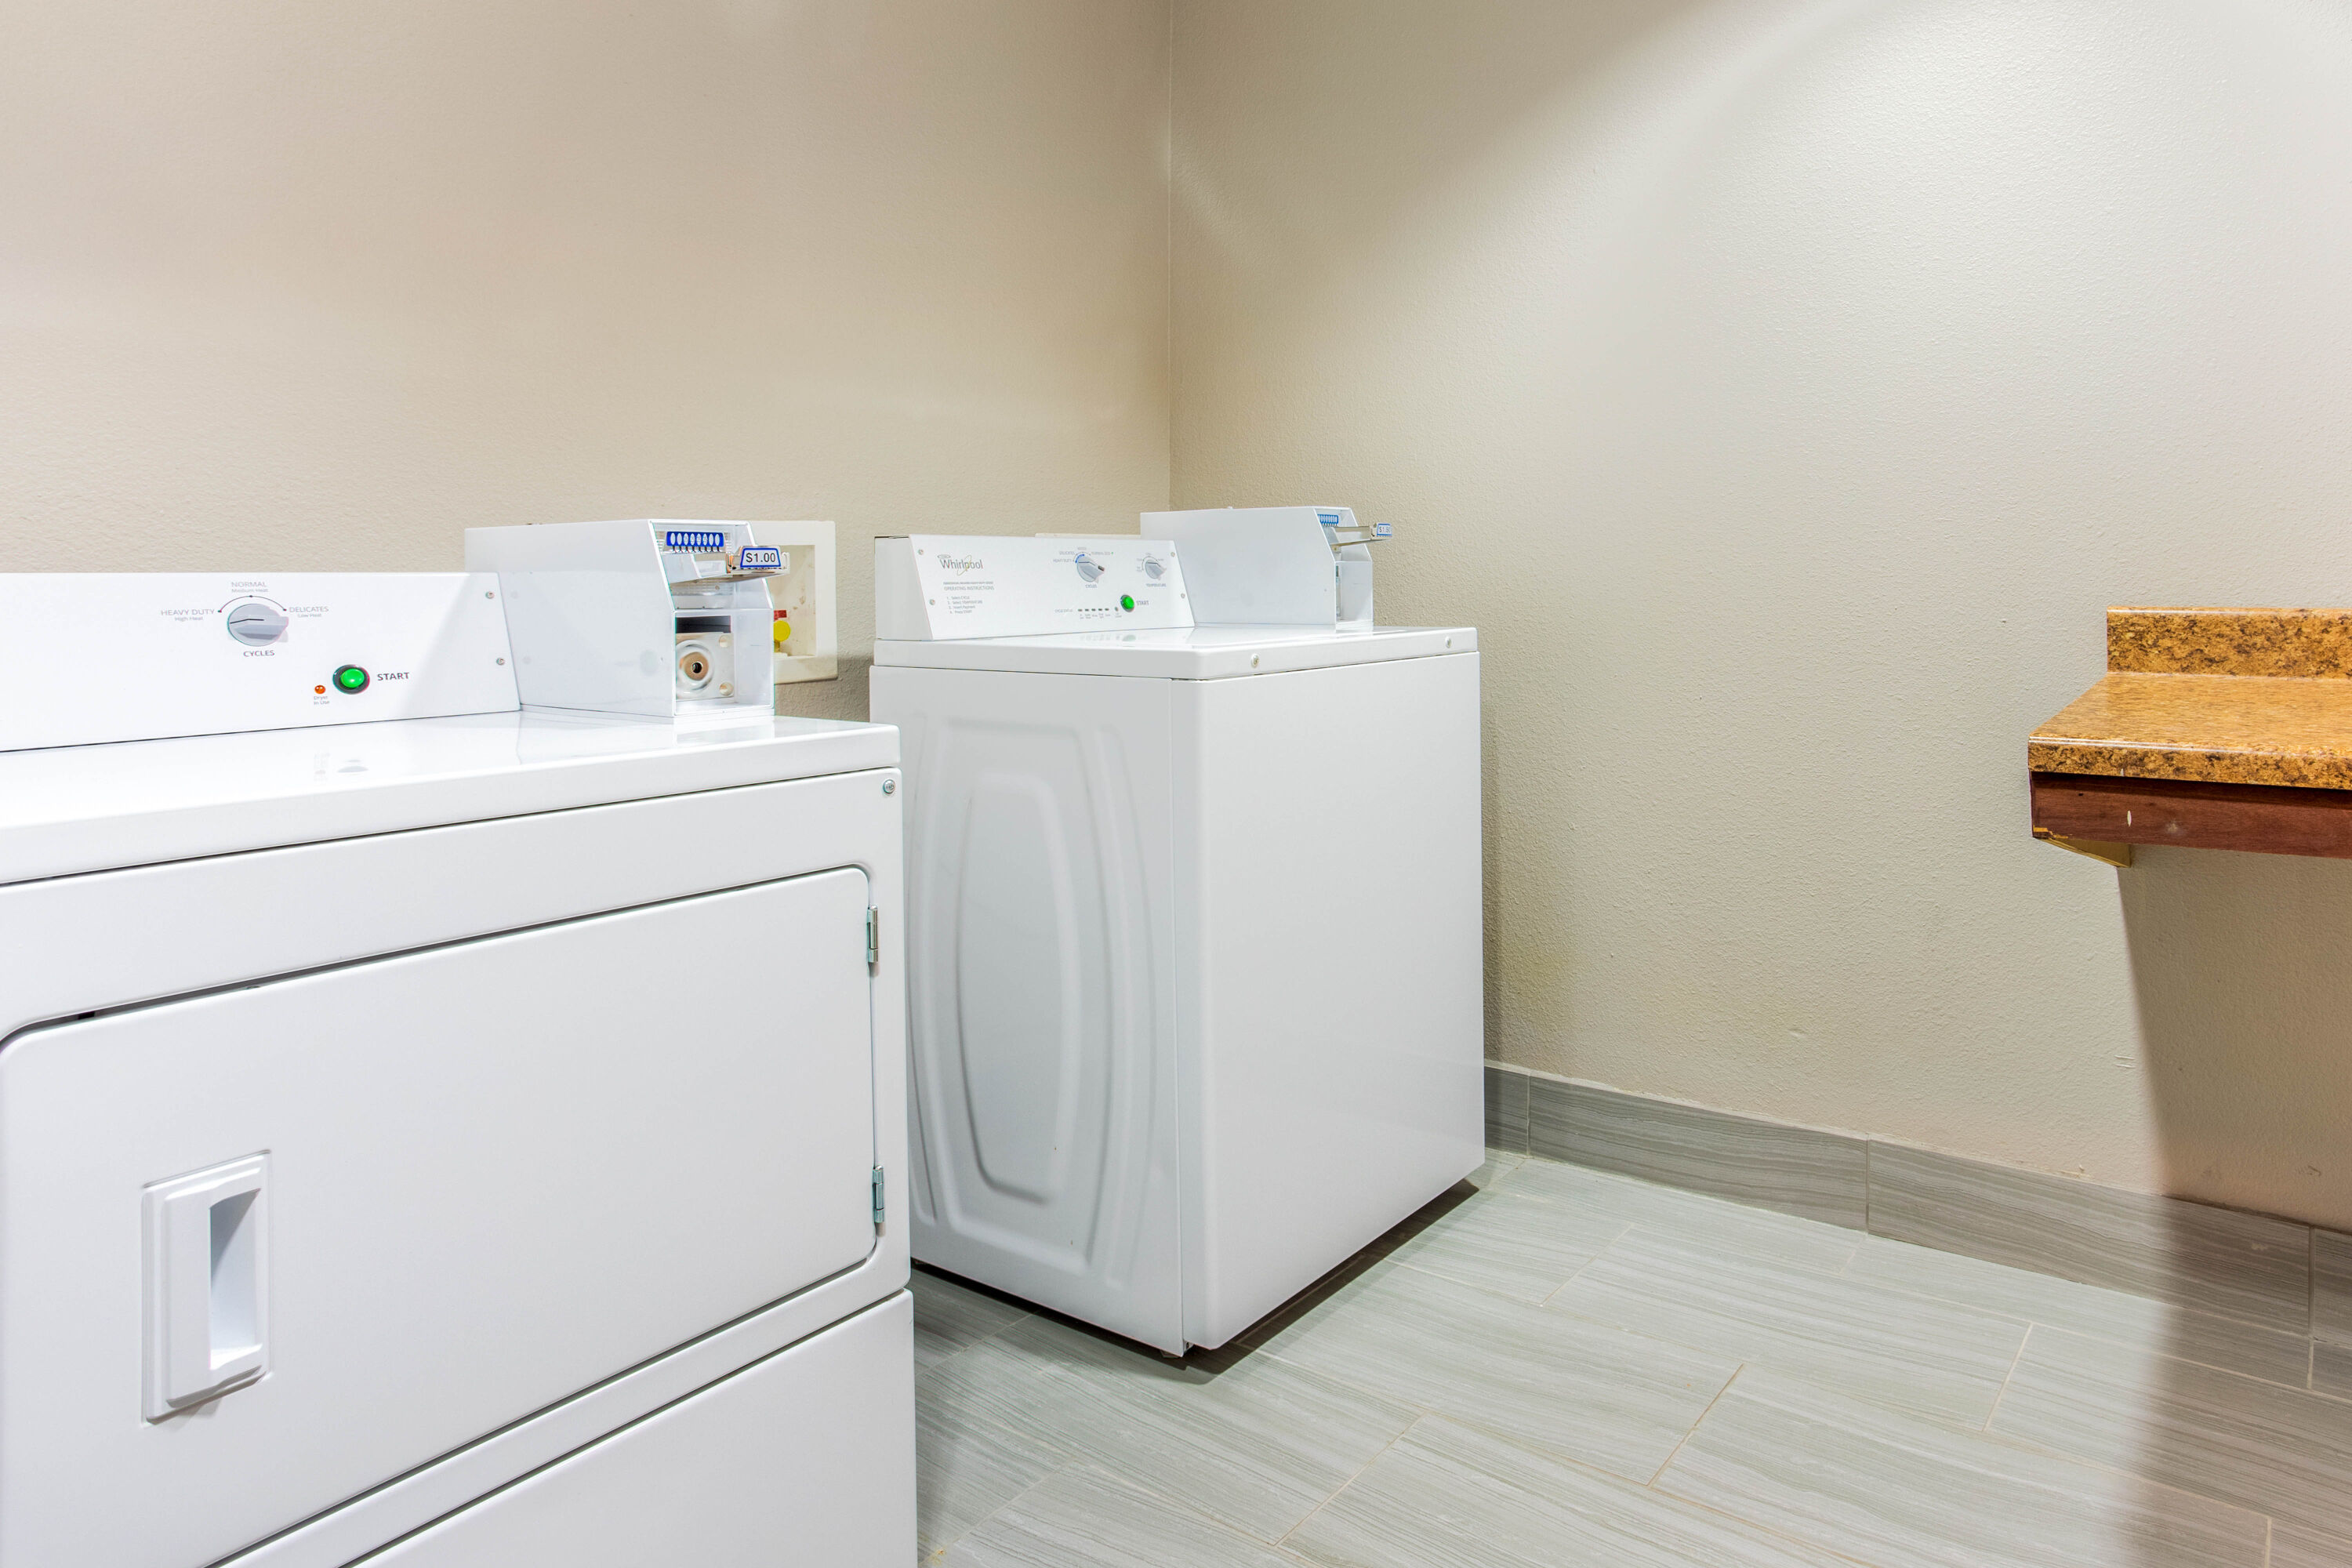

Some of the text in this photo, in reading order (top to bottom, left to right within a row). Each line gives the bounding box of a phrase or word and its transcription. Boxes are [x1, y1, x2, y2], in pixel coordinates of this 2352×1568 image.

[746, 552, 776, 563] $1.00
[939, 558, 983, 572] Whirlpool
[377, 672, 410, 681] START
